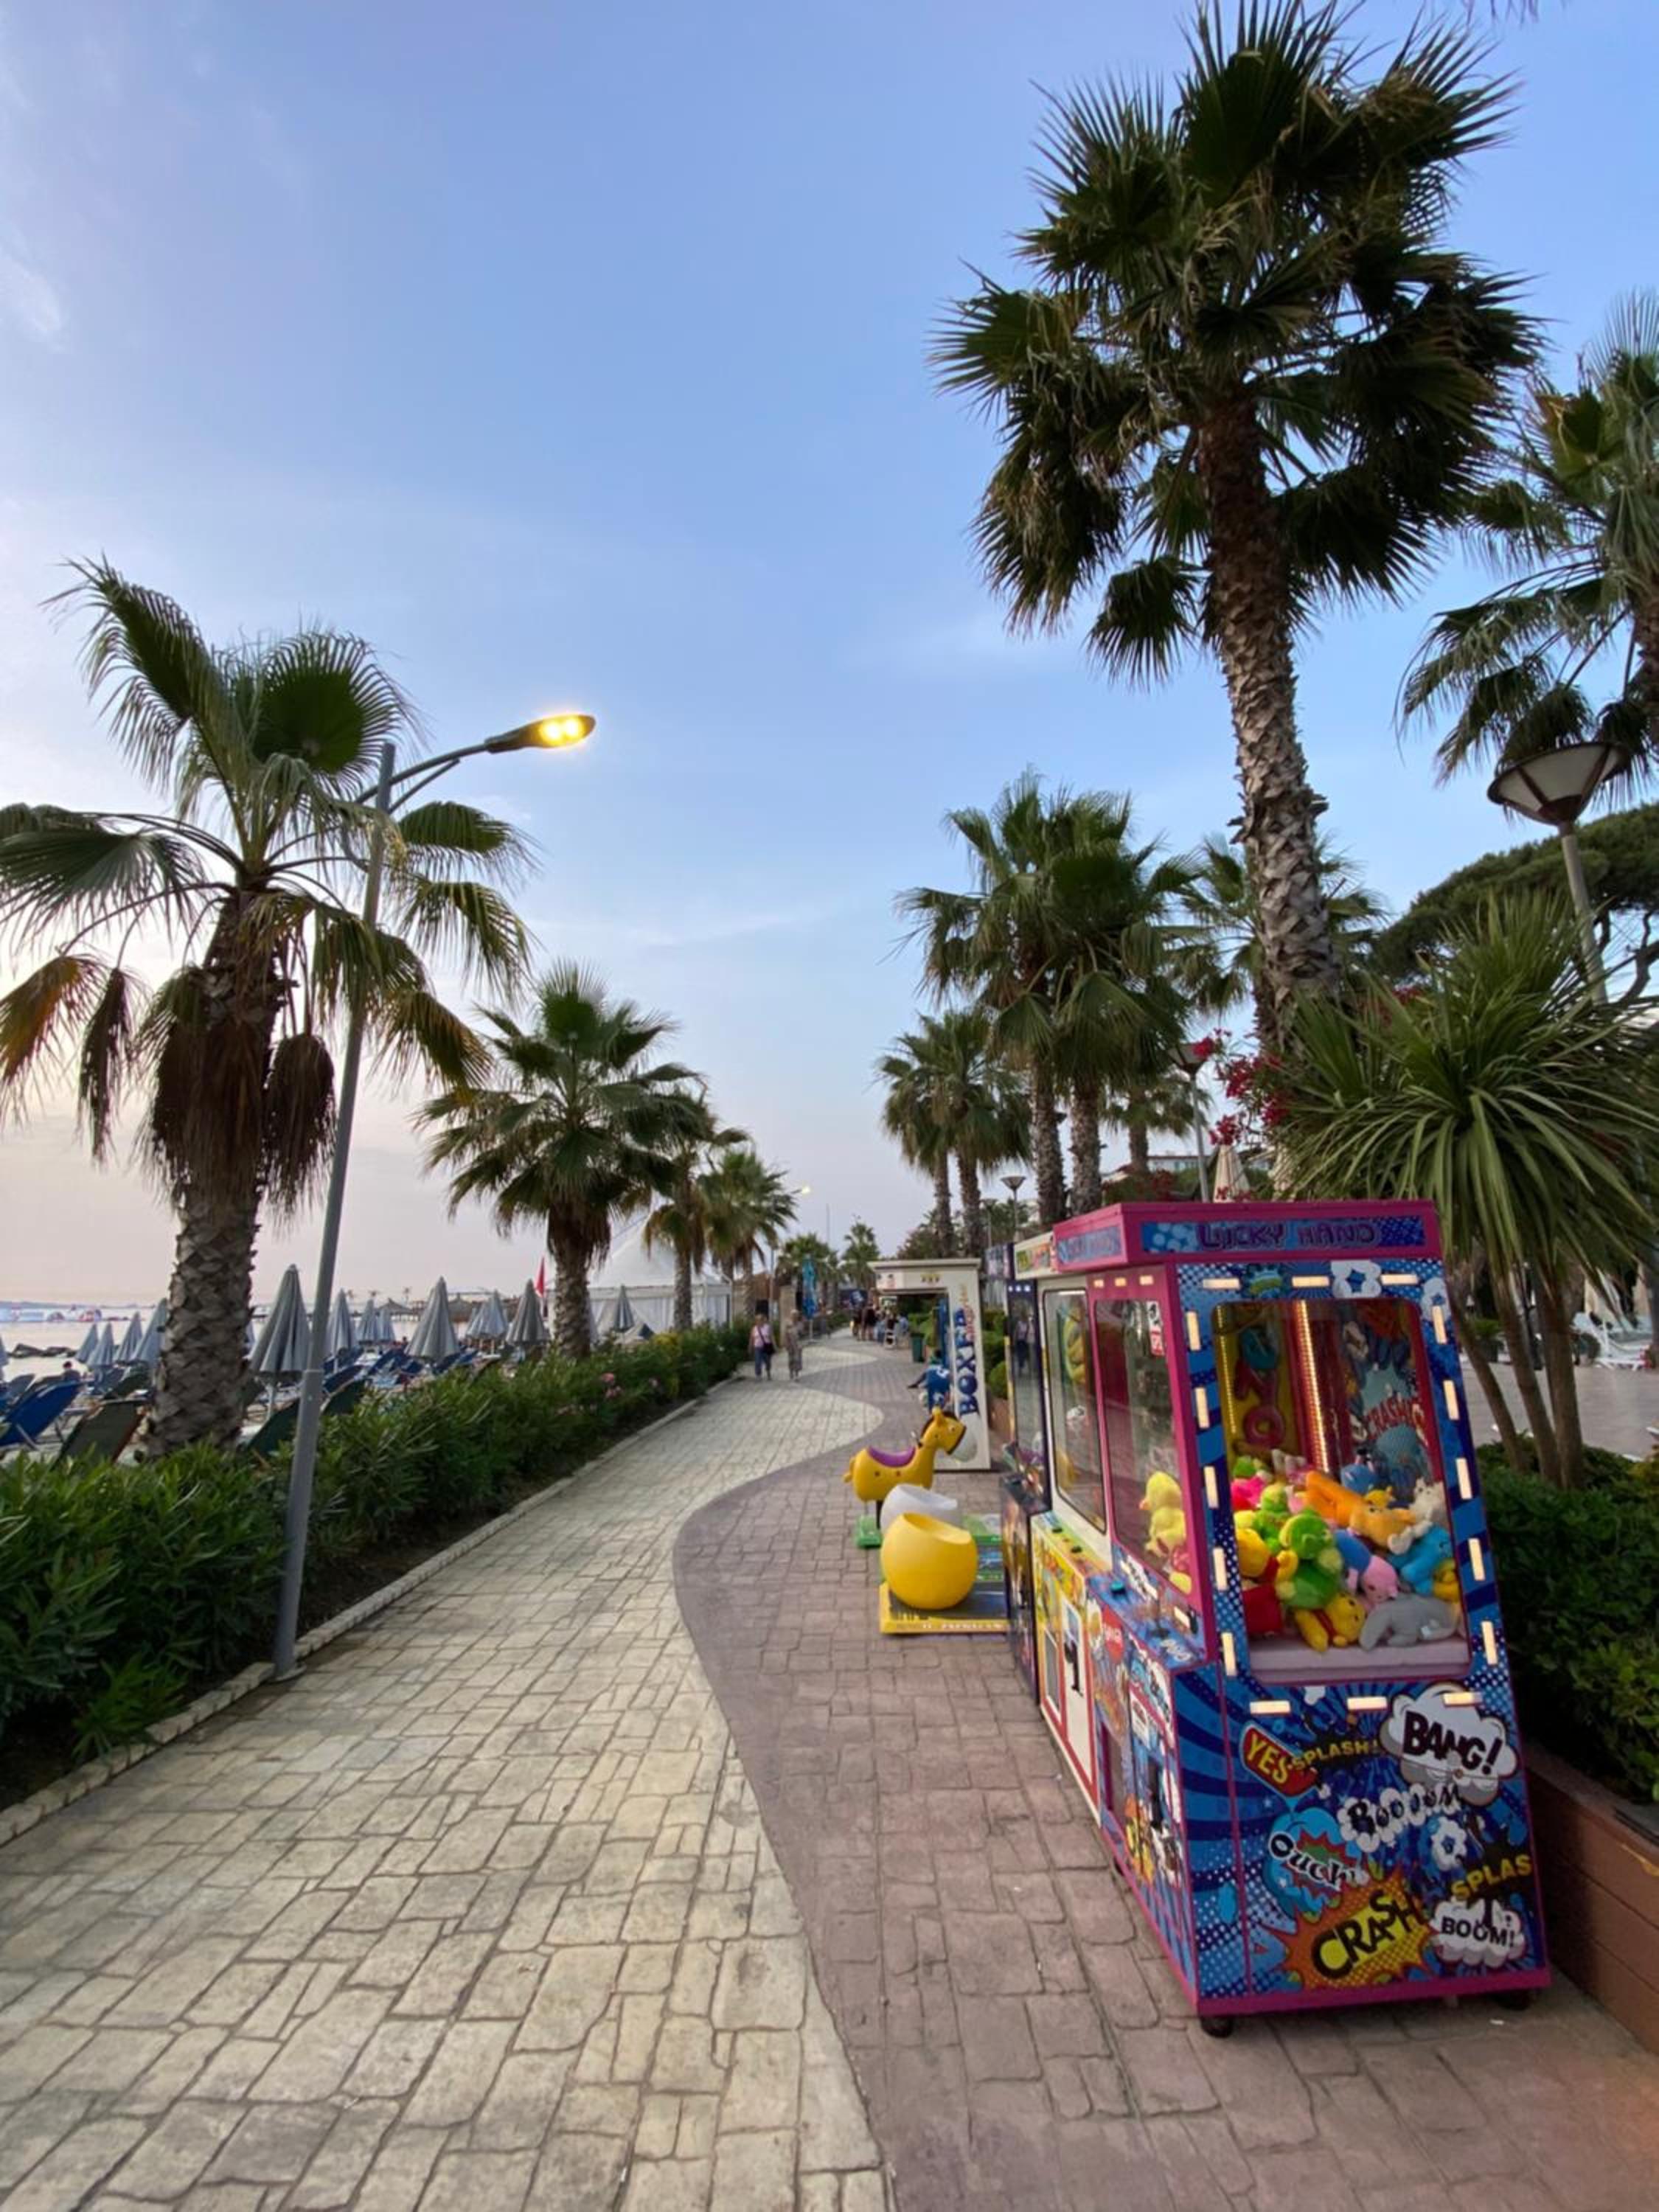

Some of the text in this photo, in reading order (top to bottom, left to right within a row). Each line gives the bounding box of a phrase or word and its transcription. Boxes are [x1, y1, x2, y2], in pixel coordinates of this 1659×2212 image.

[1195, 1221, 1376, 1249] LUCKY HAND
[1247, 1733, 1288, 1784] YES
[1403, 1711, 1503, 1775] BANG!
[1312, 1889, 1429, 1979] CRASH
[1441, 1916, 1514, 1947] BOOM!
